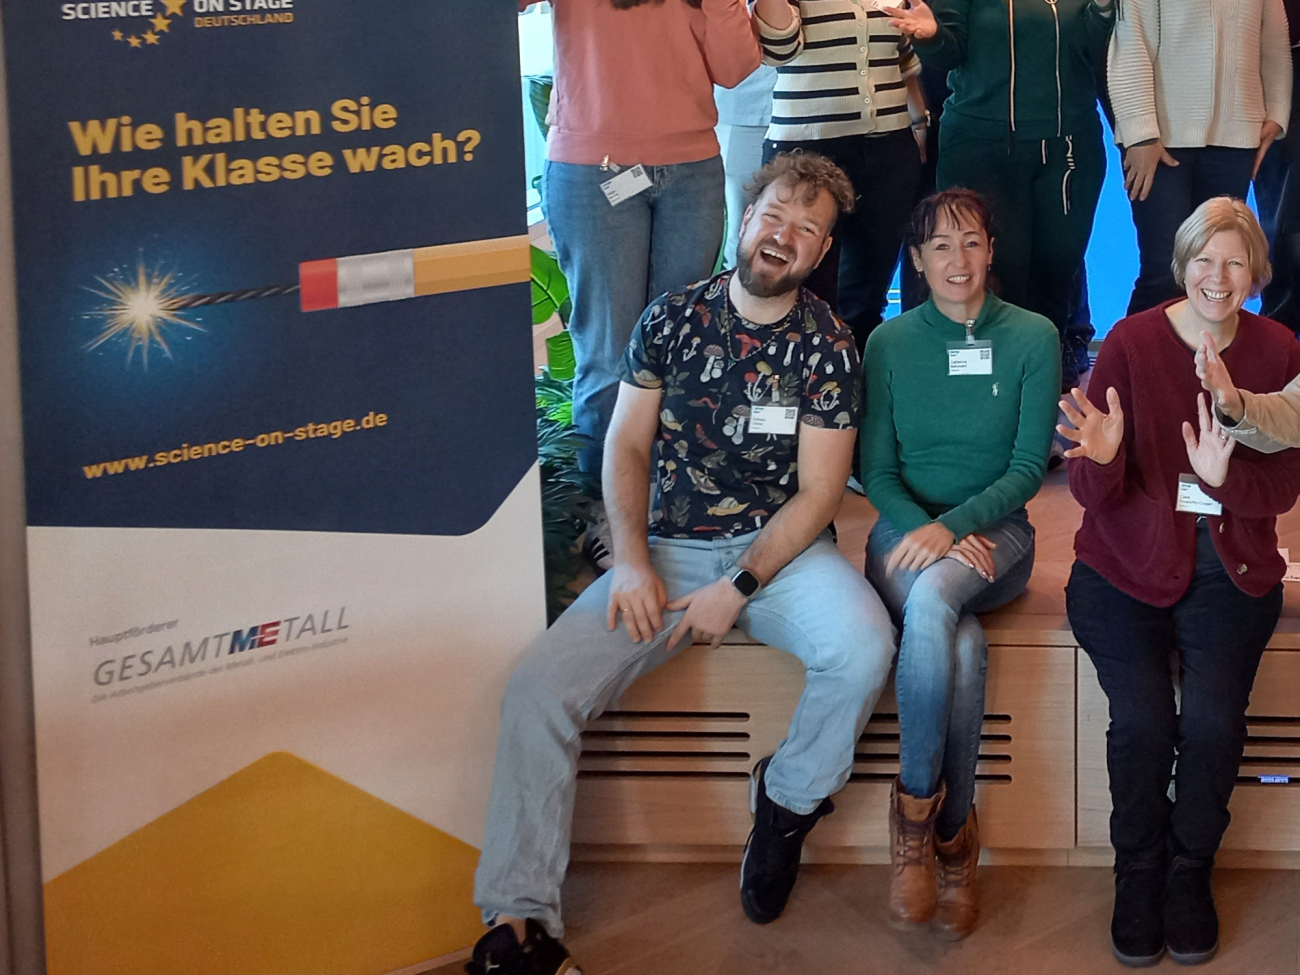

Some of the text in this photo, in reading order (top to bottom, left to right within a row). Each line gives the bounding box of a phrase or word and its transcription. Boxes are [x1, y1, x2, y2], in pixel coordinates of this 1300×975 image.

[61, 0, 153, 21] SCIENCE
[193, 12, 293, 29] DEUTSCHLAND
[69, 96, 398, 156] Wie halten Sie
[72, 129, 481, 202] Ihre Klasse wach?
[82, 411, 389, 479] www.science-on-stage.de
[93, 606, 349, 686] GESAMTMETALL
